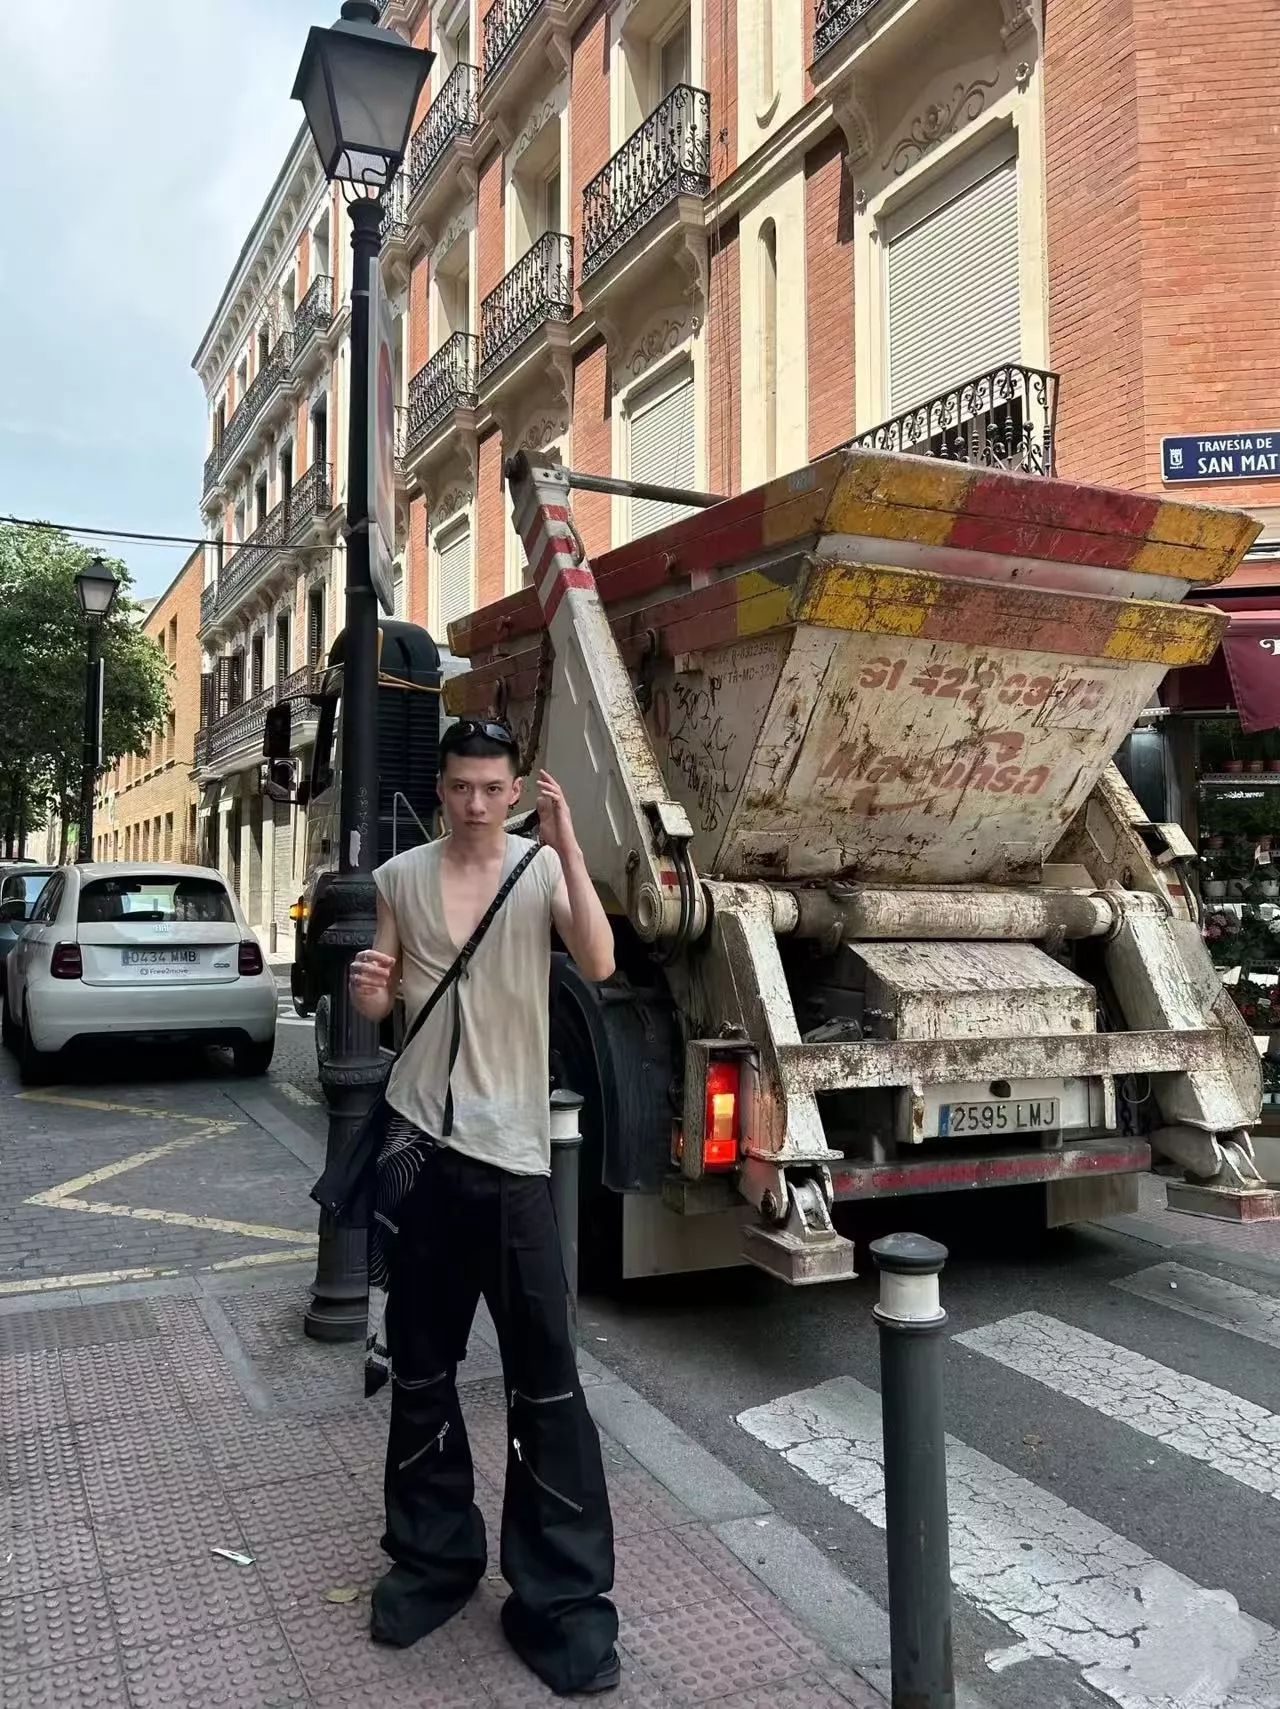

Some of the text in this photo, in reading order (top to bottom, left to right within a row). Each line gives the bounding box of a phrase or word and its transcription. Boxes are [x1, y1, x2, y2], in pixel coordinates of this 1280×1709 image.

[1197, 437, 1273, 452] TRAVESIA DE
[1198, 453, 1278, 474] SAN MAT
[132, 950, 197, 963] 0434 MMB
[953, 1101, 1055, 1132] 2595 LMJ
